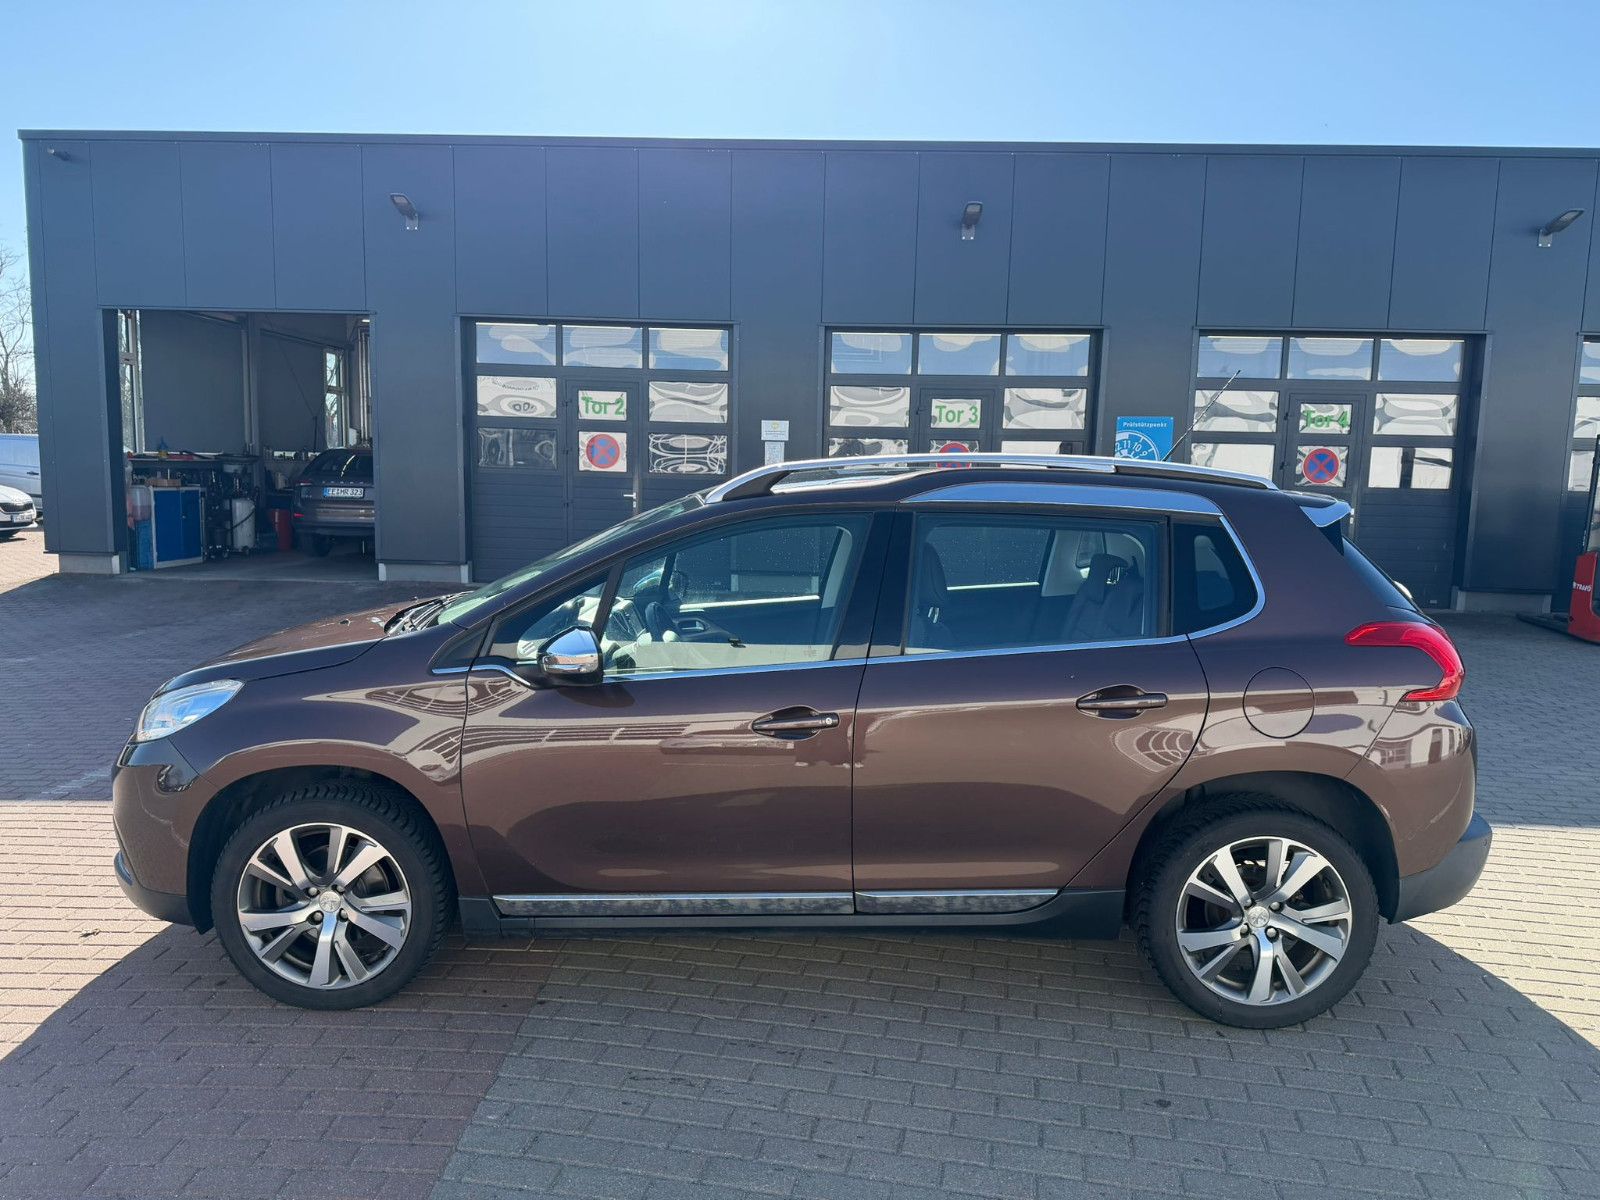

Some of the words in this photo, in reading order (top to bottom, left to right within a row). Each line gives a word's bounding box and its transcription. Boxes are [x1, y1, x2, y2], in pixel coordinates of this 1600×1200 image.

[581, 396, 609, 415] Tor
[615, 397, 625, 416] 2
[935, 405, 964, 423] Tor
[969, 405, 978, 424] 3
[1303, 410, 1334, 428] Tor
[1337, 410, 1349, 428] 4
